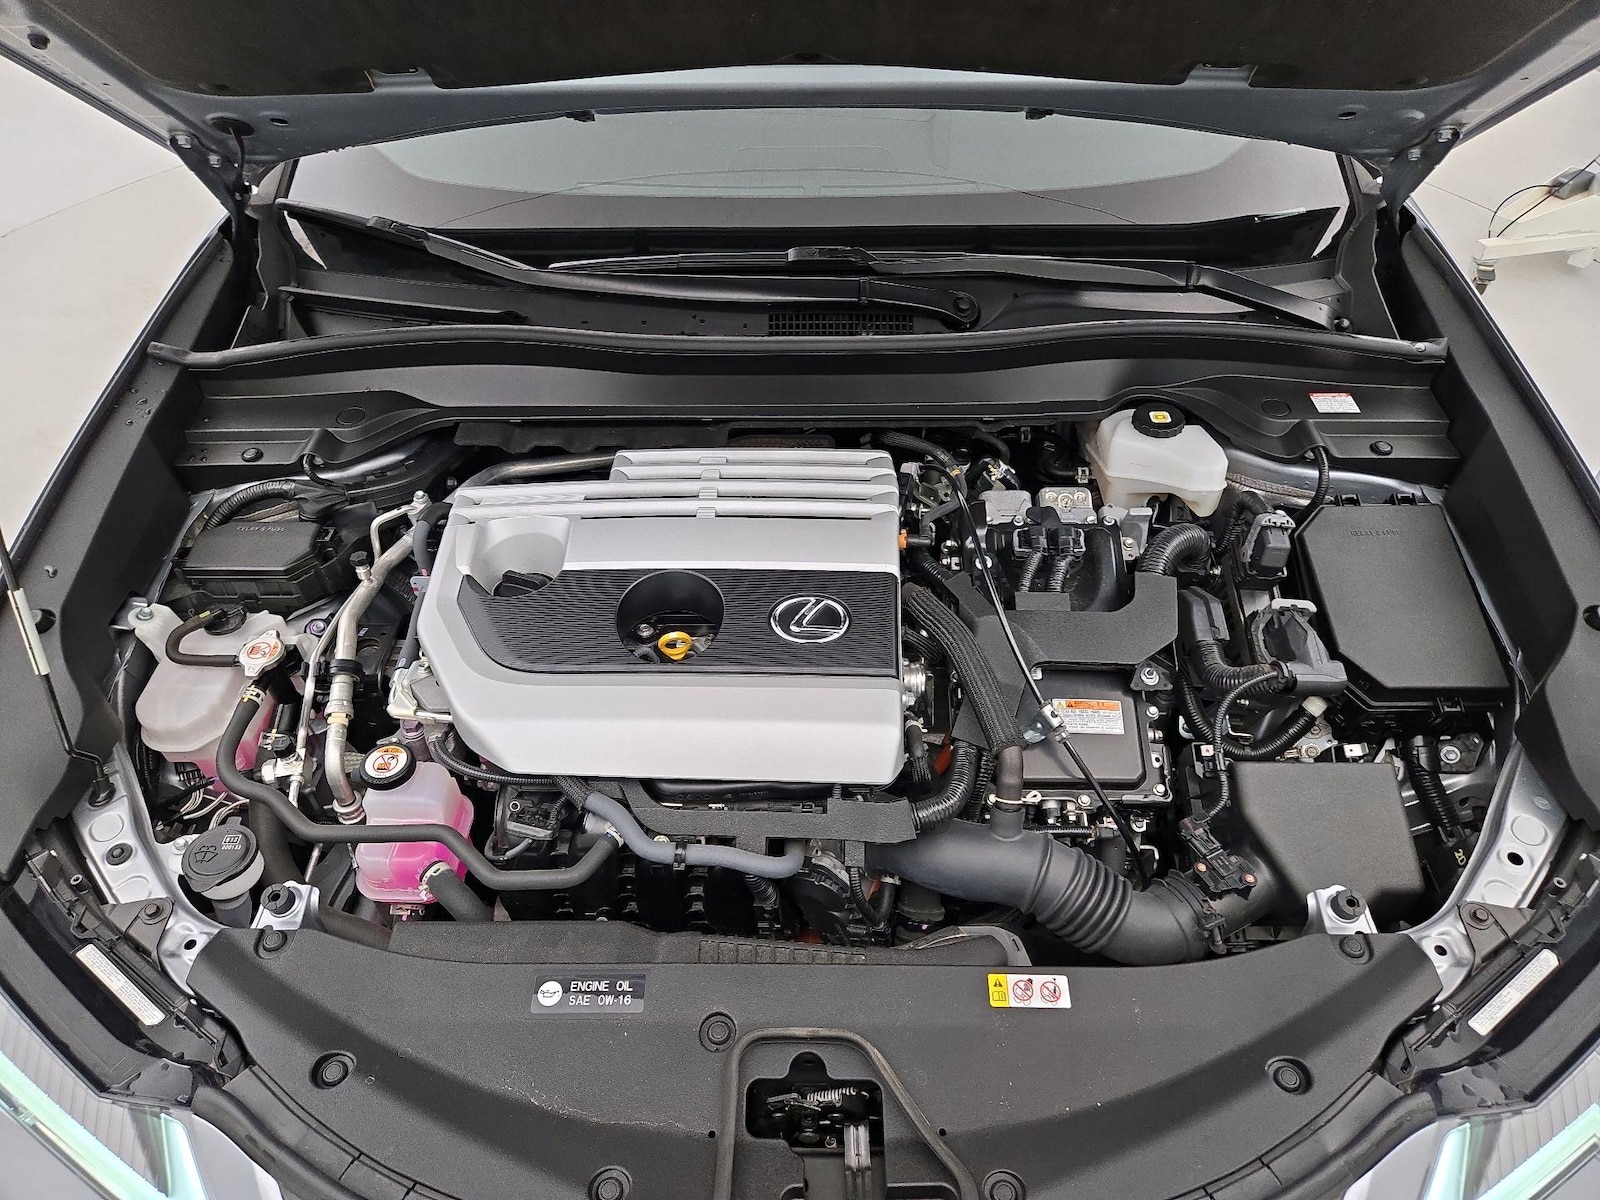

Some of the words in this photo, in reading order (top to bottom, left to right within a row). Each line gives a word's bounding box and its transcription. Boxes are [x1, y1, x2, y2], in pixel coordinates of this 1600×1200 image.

[570, 980, 610, 992] ENGINE
[616, 980, 633, 991] OIL
[568, 994, 591, 1006] SAE
[597, 994, 632, 1006] 0W-16
